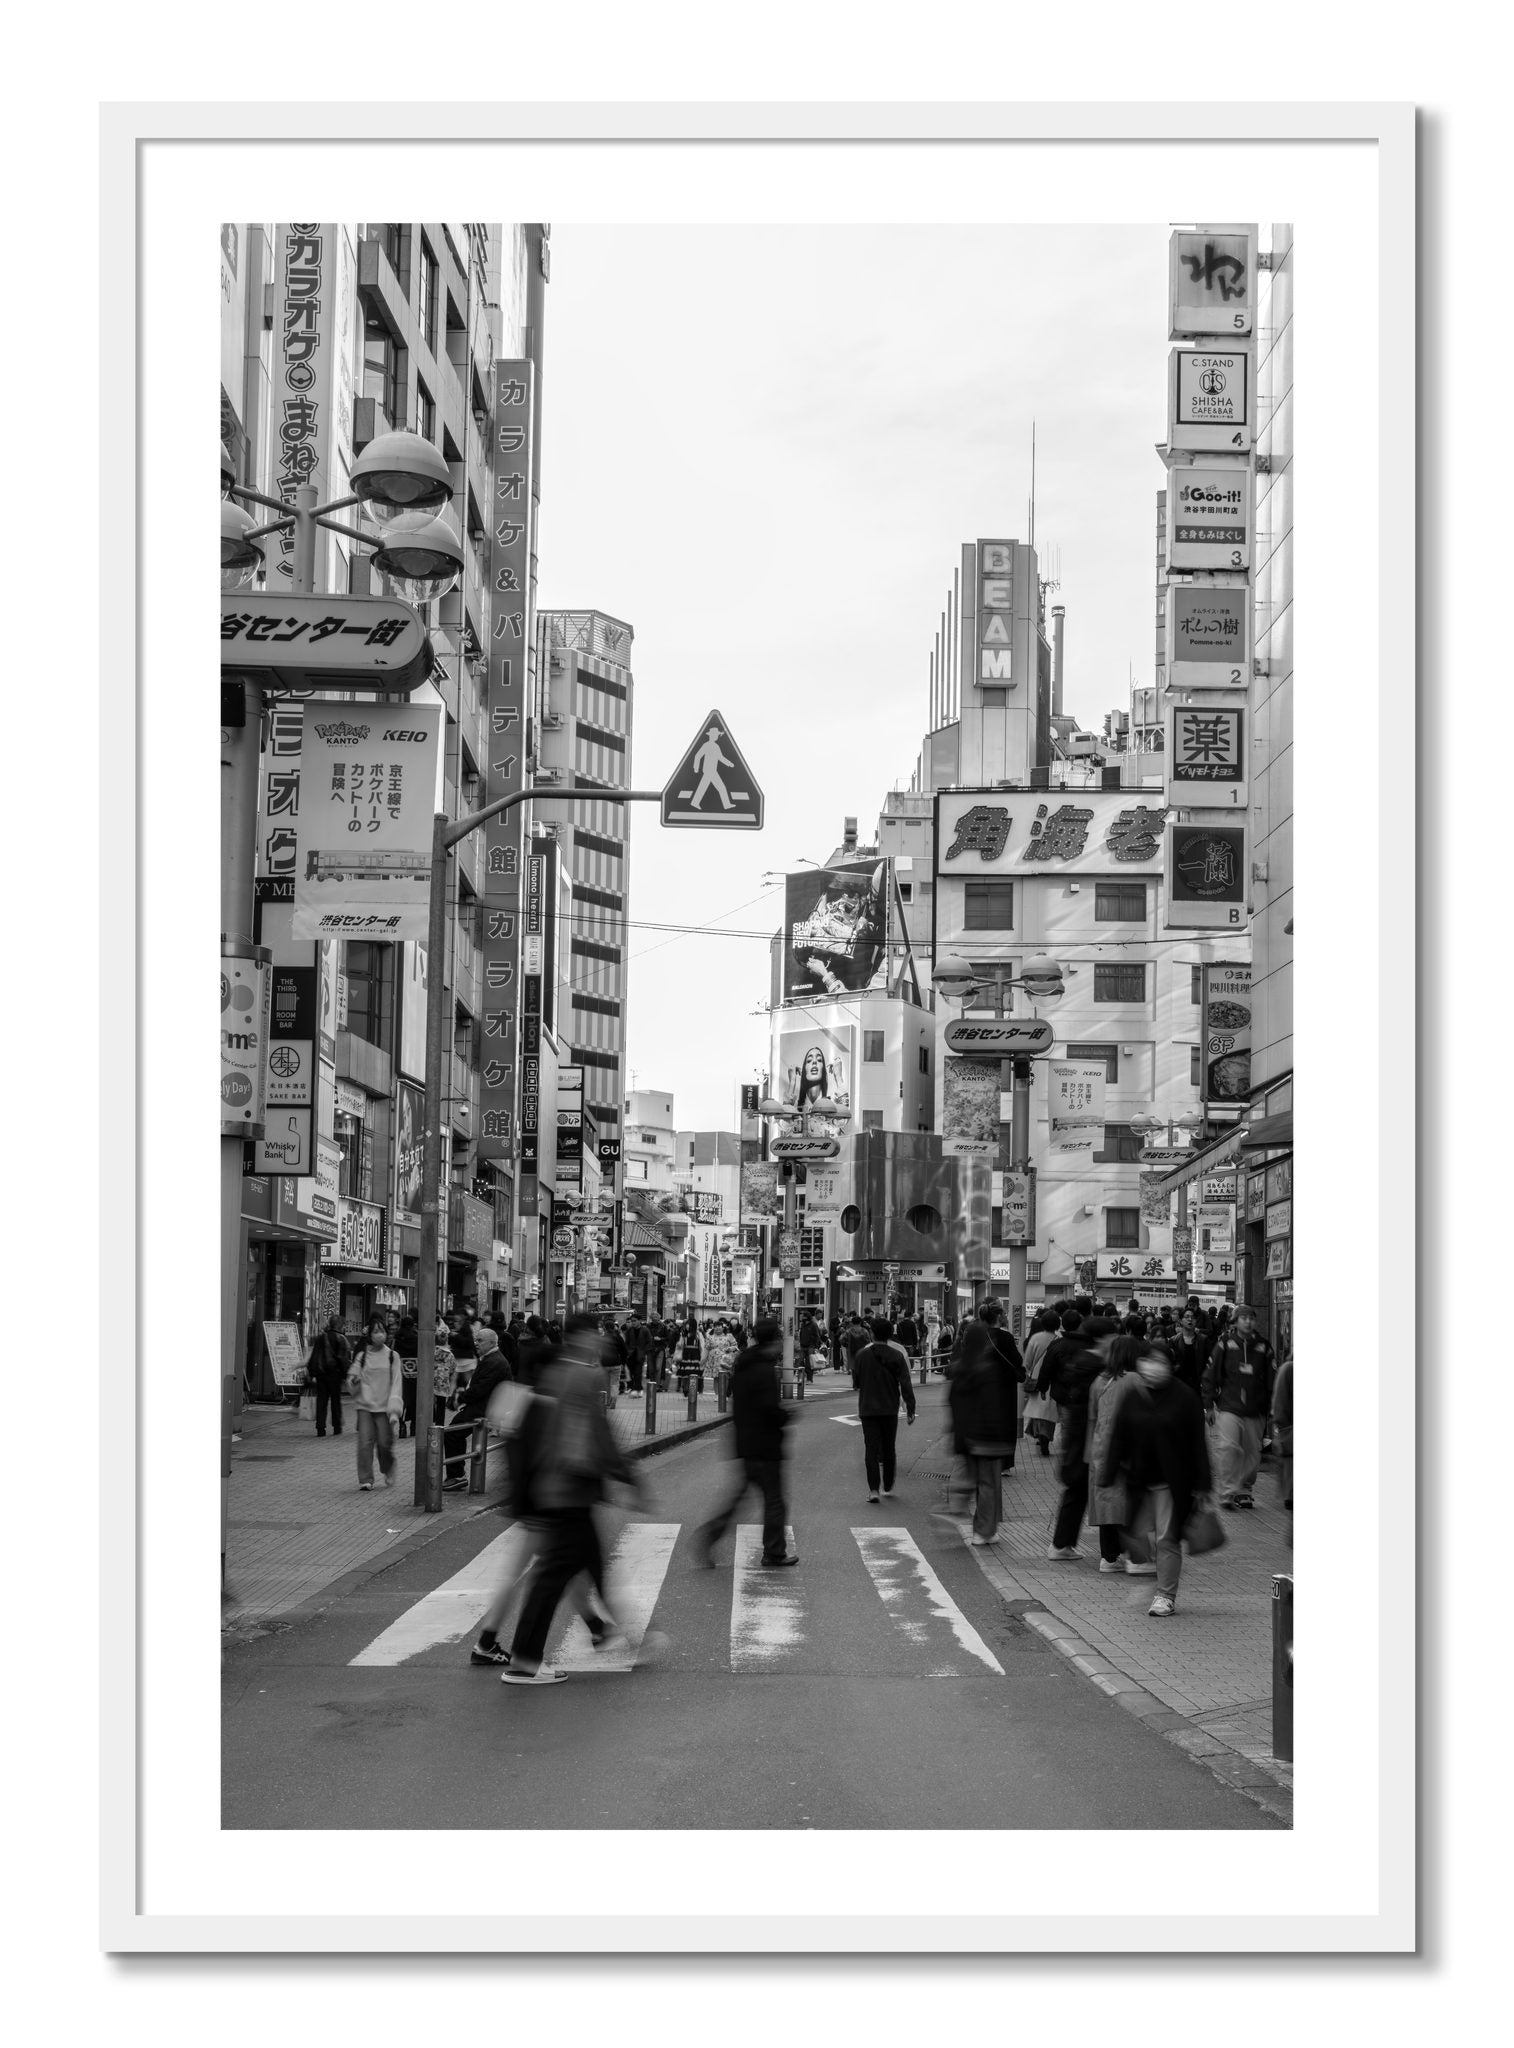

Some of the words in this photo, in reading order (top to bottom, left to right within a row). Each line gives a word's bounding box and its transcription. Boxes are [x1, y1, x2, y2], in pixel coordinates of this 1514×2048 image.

[284, 236, 322, 363] カラオケ
[1233, 314, 1245, 329] 5
[1192, 358, 1234, 367] C.STAND
[1192, 397, 1233, 406] SHISHA
[1192, 407, 1233, 415] CAFE&BAR
[1232, 432, 1243, 447] 4
[1190, 487, 1241, 502] Goo-it!
[1184, 506, 1239, 514] 渋谷宇田川町店
[1179, 529, 1242, 540] 全身もみほぐし
[1231, 550, 1242, 566] 3
[982, 543, 1013, 679] BEAM
[1180, 617, 1240, 635] ポムの樹
[1230, 669, 1241, 684] 2
[383, 730, 428, 742] KEIO
[1183, 714, 1230, 762] 薬
[331, 763, 346, 803] 冒険へ
[348, 763, 365, 833] カントーの
[387, 764, 403, 820] 京王線で
[1230, 789, 1238, 804] 1
[531, 860, 540, 893] kimono
[318, 914, 402, 927] 渋谷センター街
[530, 898, 538, 930] hearts
[1229, 908, 1240, 923] B
[952, 1028, 1047, 1040] 渋谷センター街
[1208, 1036, 1235, 1055] 6F
[232, 1081, 251, 1094] Day!
[266, 1142, 296, 1152] Whisky
[601, 1145, 620, 1155] GU
[773, 1142, 833, 1151] 渋谷センター街
[1143, 1151, 1196, 1159] 渋谷センター街
[1110, 1256, 1164, 1277] 兆楽
